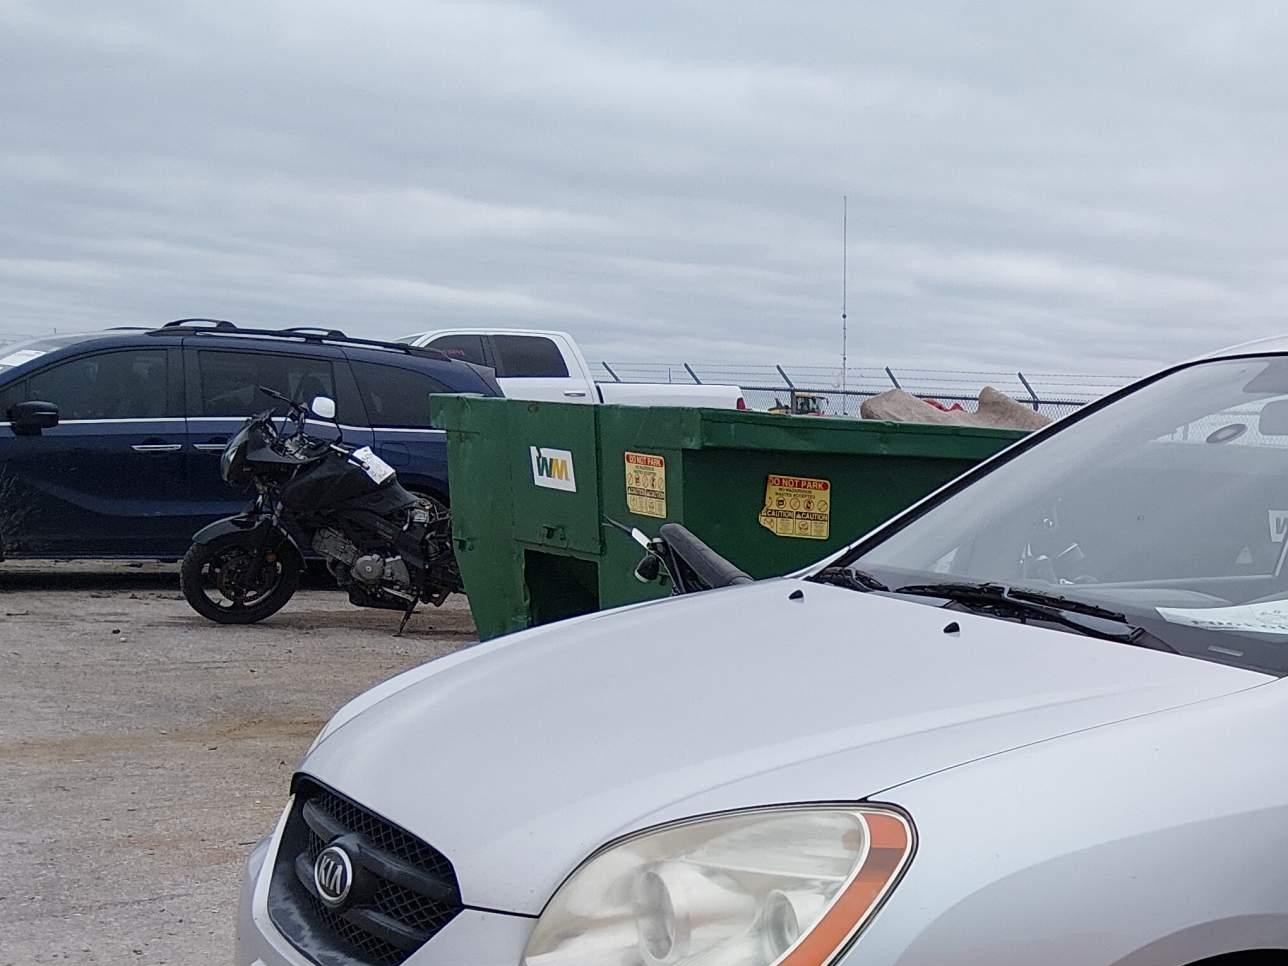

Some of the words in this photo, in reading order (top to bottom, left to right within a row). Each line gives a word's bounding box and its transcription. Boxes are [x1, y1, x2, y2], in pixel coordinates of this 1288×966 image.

[536, 456, 569, 480] WM
[782, 479, 800, 488] NOT
[801, 480, 824, 490] PARK
[767, 510, 794, 519] CAUTION
[802, 512, 828, 521] CAUTION
[319, 855, 343, 895] KIA
